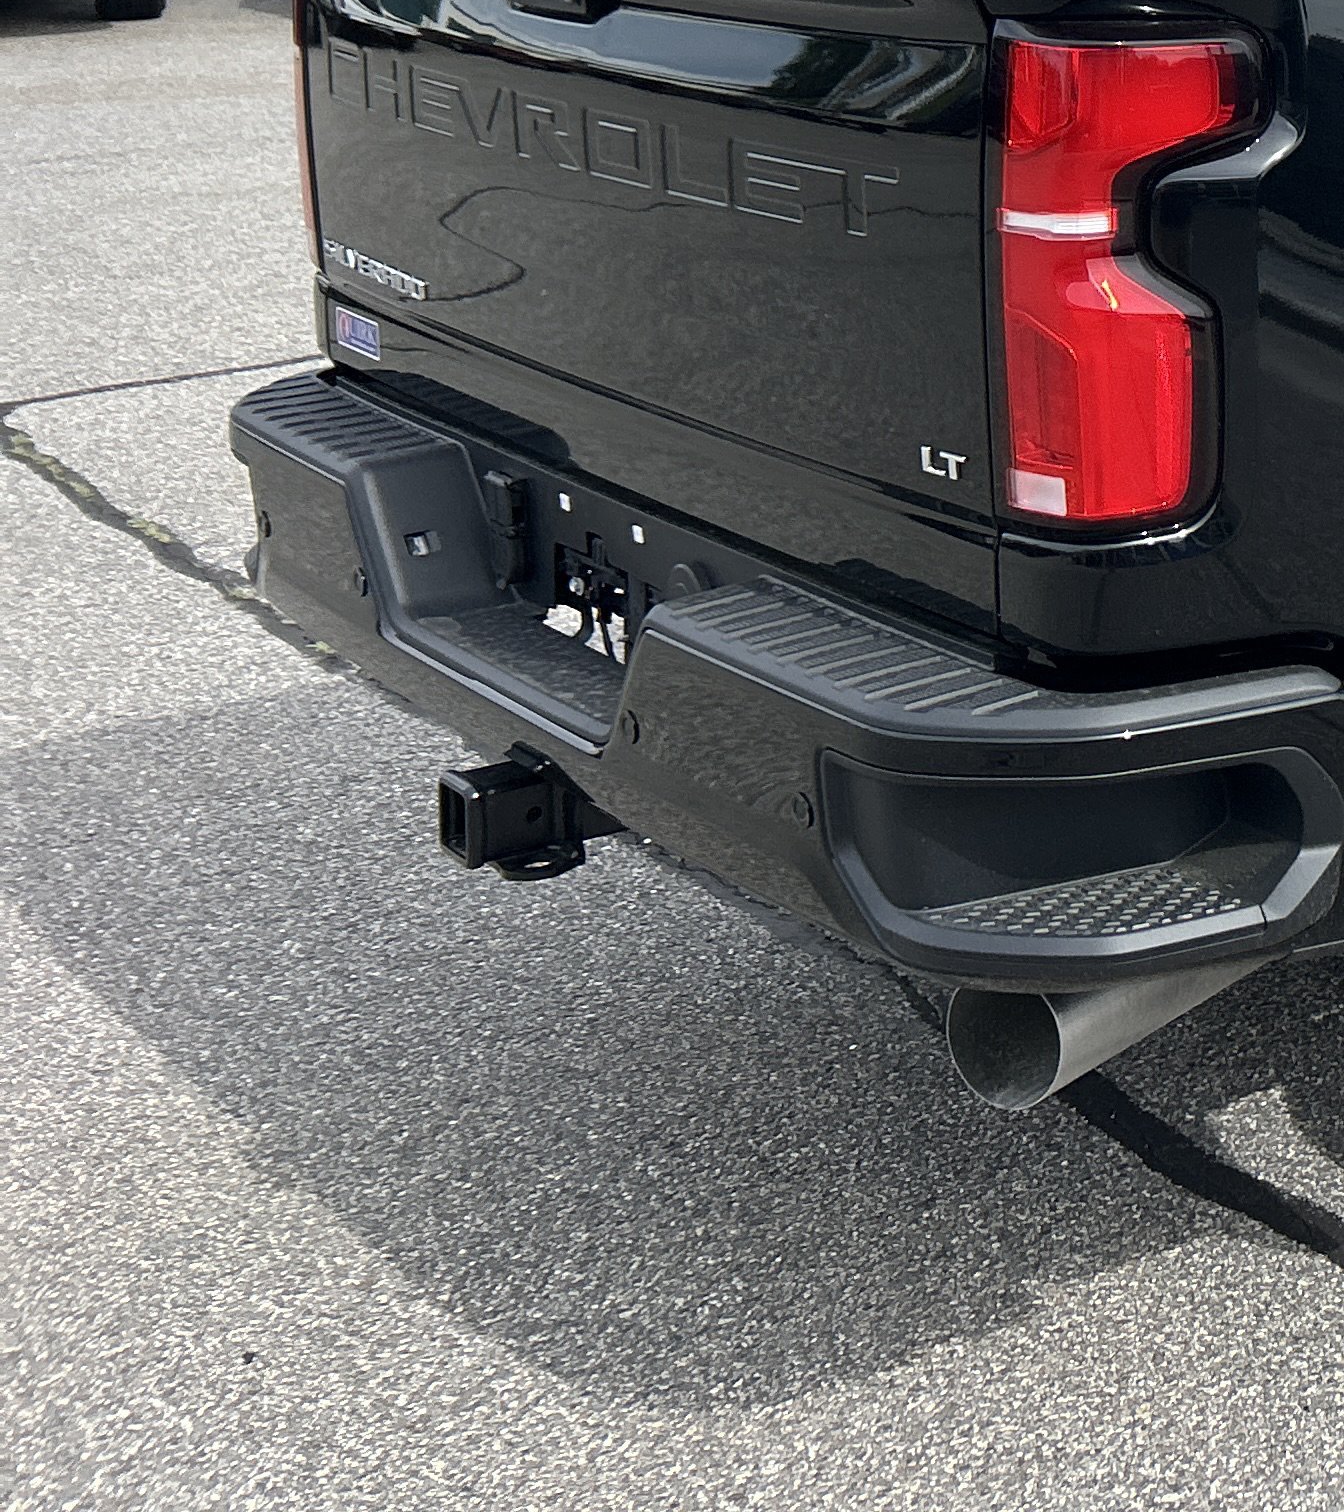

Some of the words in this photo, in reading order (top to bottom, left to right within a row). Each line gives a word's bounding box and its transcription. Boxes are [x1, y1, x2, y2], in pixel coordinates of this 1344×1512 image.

[328, 38, 899, 238] CHEVROLET
[323, 237, 428, 301] SILVERADO
[920, 446, 967, 481] LT
